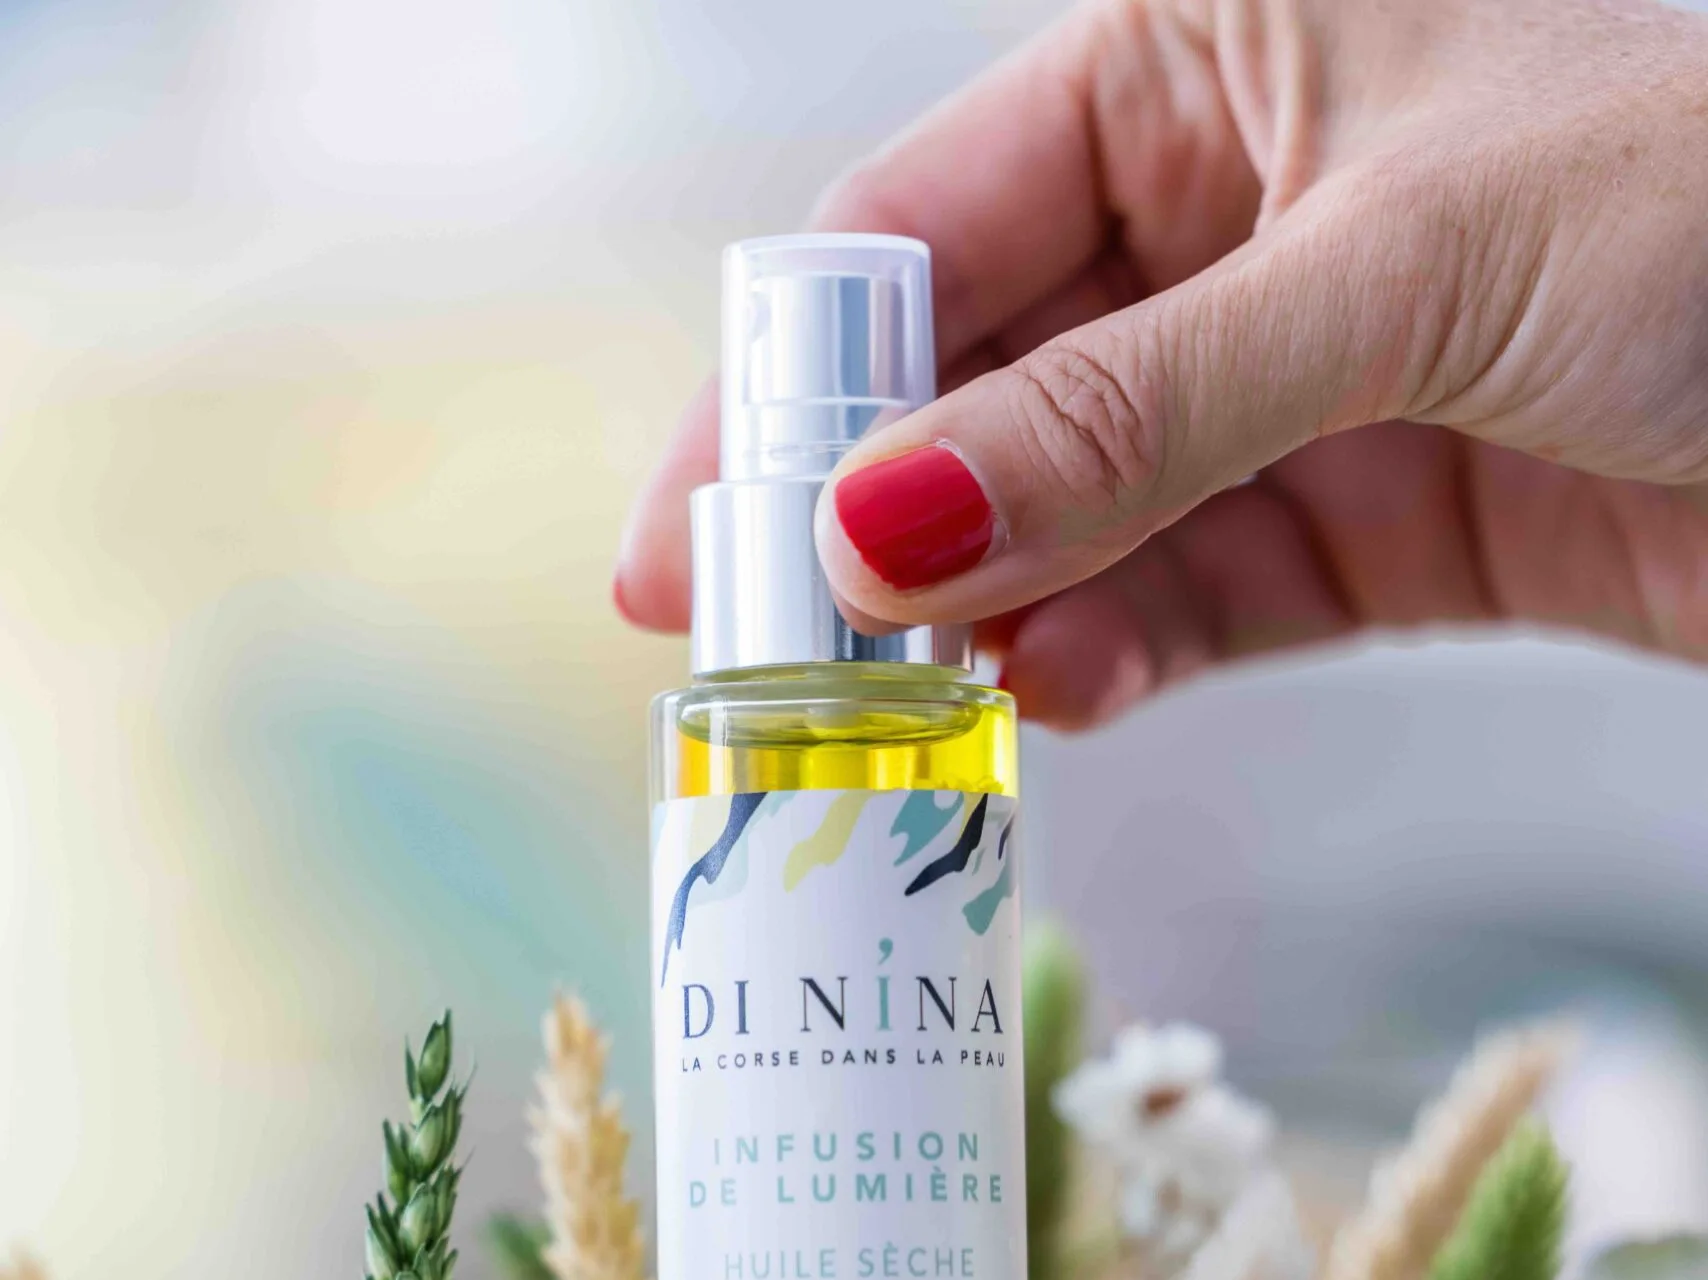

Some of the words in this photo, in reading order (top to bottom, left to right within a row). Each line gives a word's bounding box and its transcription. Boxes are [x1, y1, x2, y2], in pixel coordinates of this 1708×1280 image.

[681, 980, 750, 1039] DI
[682, 1056, 702, 1073] LA
[717, 1050, 798, 1069] CORSE
[821, 1048, 896, 1065] DANS
[916, 1049, 944, 1065] LA
[961, 1050, 1004, 1068] PEAU
[714, 1131, 978, 1164] INFUSION
[690, 1178, 737, 1208] DE
[777, 1166, 1002, 1204] LUMIÈRE
[725, 1248, 836, 1280] HUILE
[857, 1241, 974, 1277] SÈCHE
